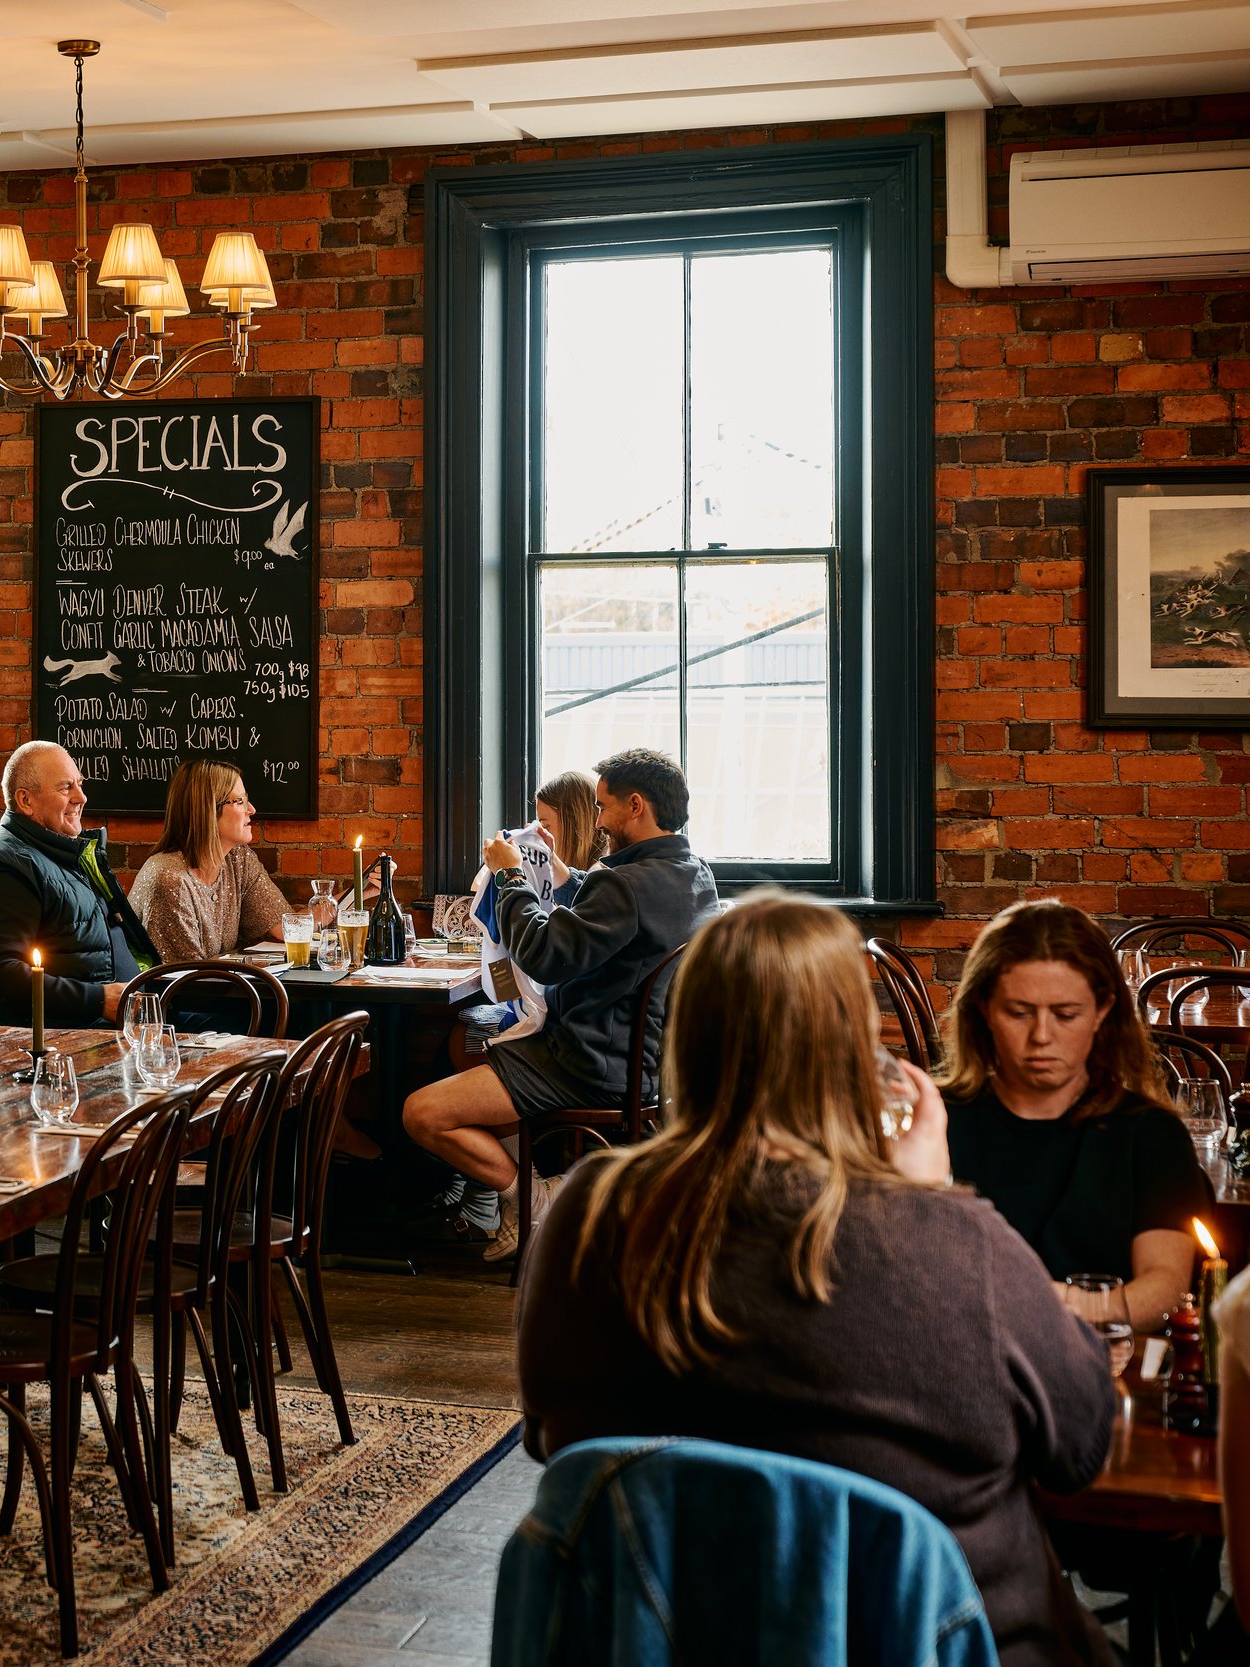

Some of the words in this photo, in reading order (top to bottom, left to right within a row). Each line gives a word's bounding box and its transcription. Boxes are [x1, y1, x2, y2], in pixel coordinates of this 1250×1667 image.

[70, 414, 286, 477] SPECIALS
[56, 518, 106, 546] GRILLED
[115, 517, 181, 545] CHERMOULA
[187, 514, 239, 544] CHICKEN
[58, 548, 112, 571] SKEWERS
[59, 589, 104, 617] WAGYU
[113, 584, 166, 618] DENVER
[177, 583, 228, 615] STEAK
[62, 619, 103, 650] CONFIT
[114, 620, 155, 649] GARLIC
[161, 615, 240, 647] MACADAMIA
[249, 615, 292, 649] SALSA
[138, 654, 146, 667] &
[147, 649, 194, 673] TOBACCO
[203, 648, 246, 673] ONIONS
[254, 663, 284, 684] 700g
[289, 661, 309, 680] $98
[244, 681, 275, 702] 750g
[279, 682, 309, 699] $105
[55, 695, 102, 721] POTATO
[107, 691, 148, 720] SALAD
[137, 723, 177, 750] SALTED
[185, 724, 239, 750] KOMBU
[249, 727, 260, 747] &
[72, 755, 110, 782] KLED
